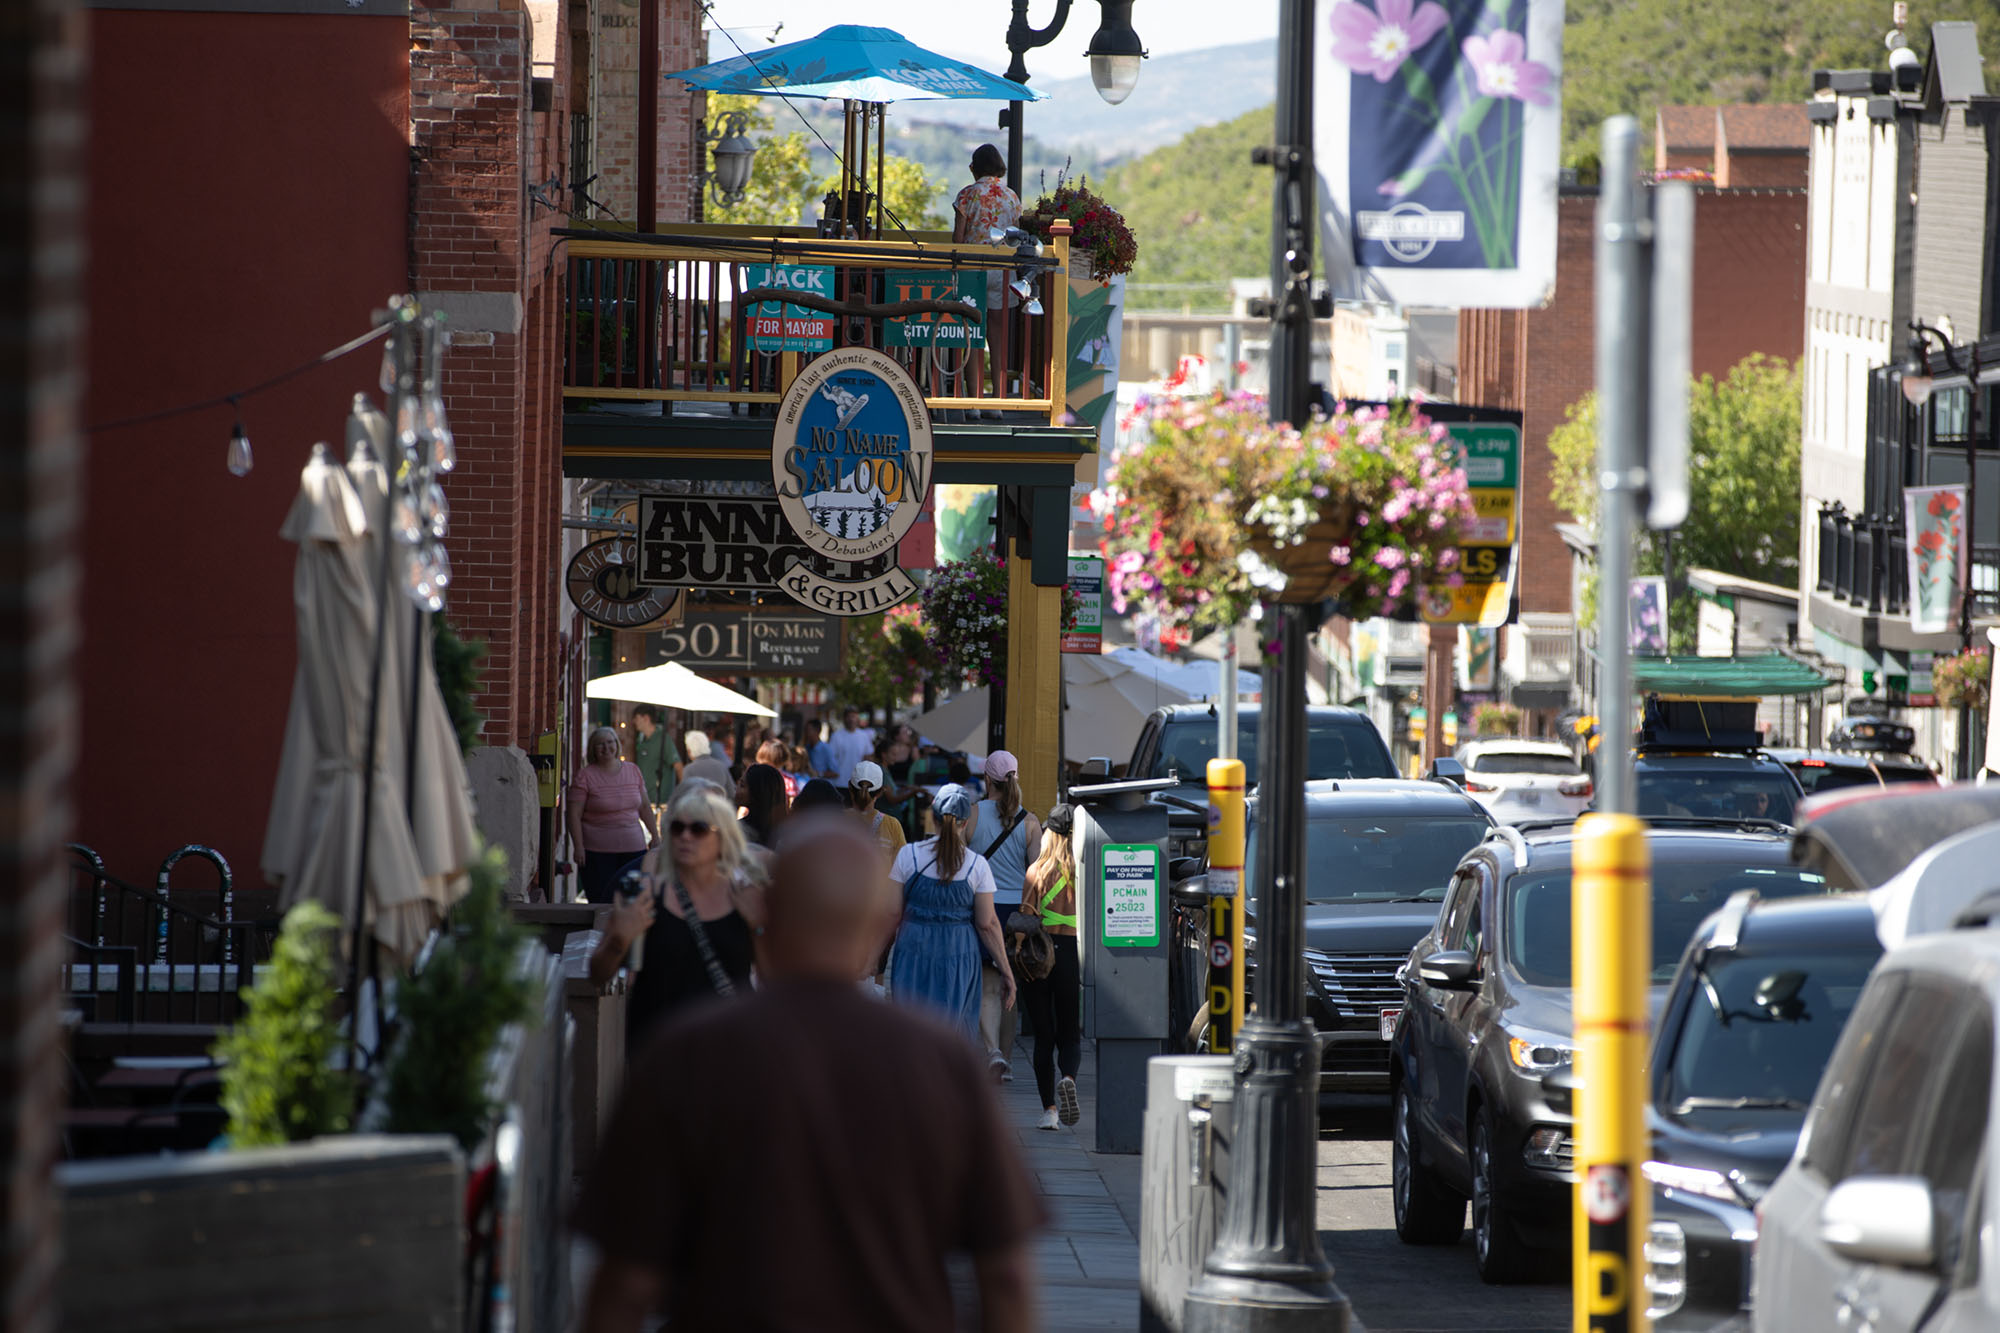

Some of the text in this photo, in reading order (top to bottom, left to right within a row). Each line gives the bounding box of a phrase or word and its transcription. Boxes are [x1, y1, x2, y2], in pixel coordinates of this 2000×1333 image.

[880, 67, 973, 83] KONA
[930, 80, 988, 90] WAVE
[758, 268, 824, 289] JACK
[757, 320, 824, 336] FOR MAYOR
[904, 325, 929, 338] CITY
[785, 354, 925, 431] america's last authentic miners organization
[811, 426, 900, 456] NO NAME
[778, 444, 929, 503] SALOON
[804, 529, 896, 555] of Debauchery
[581, 589, 663, 622] GALLERY
[753, 623, 825, 639] ON MAIN
[659, 623, 744, 658] 501
[760, 641, 820, 654] RESTAURANT
[772, 654, 804, 666] & PUB
[1113, 888, 1147, 897] PCMAIN
[1115, 903, 1145, 912] 25023
